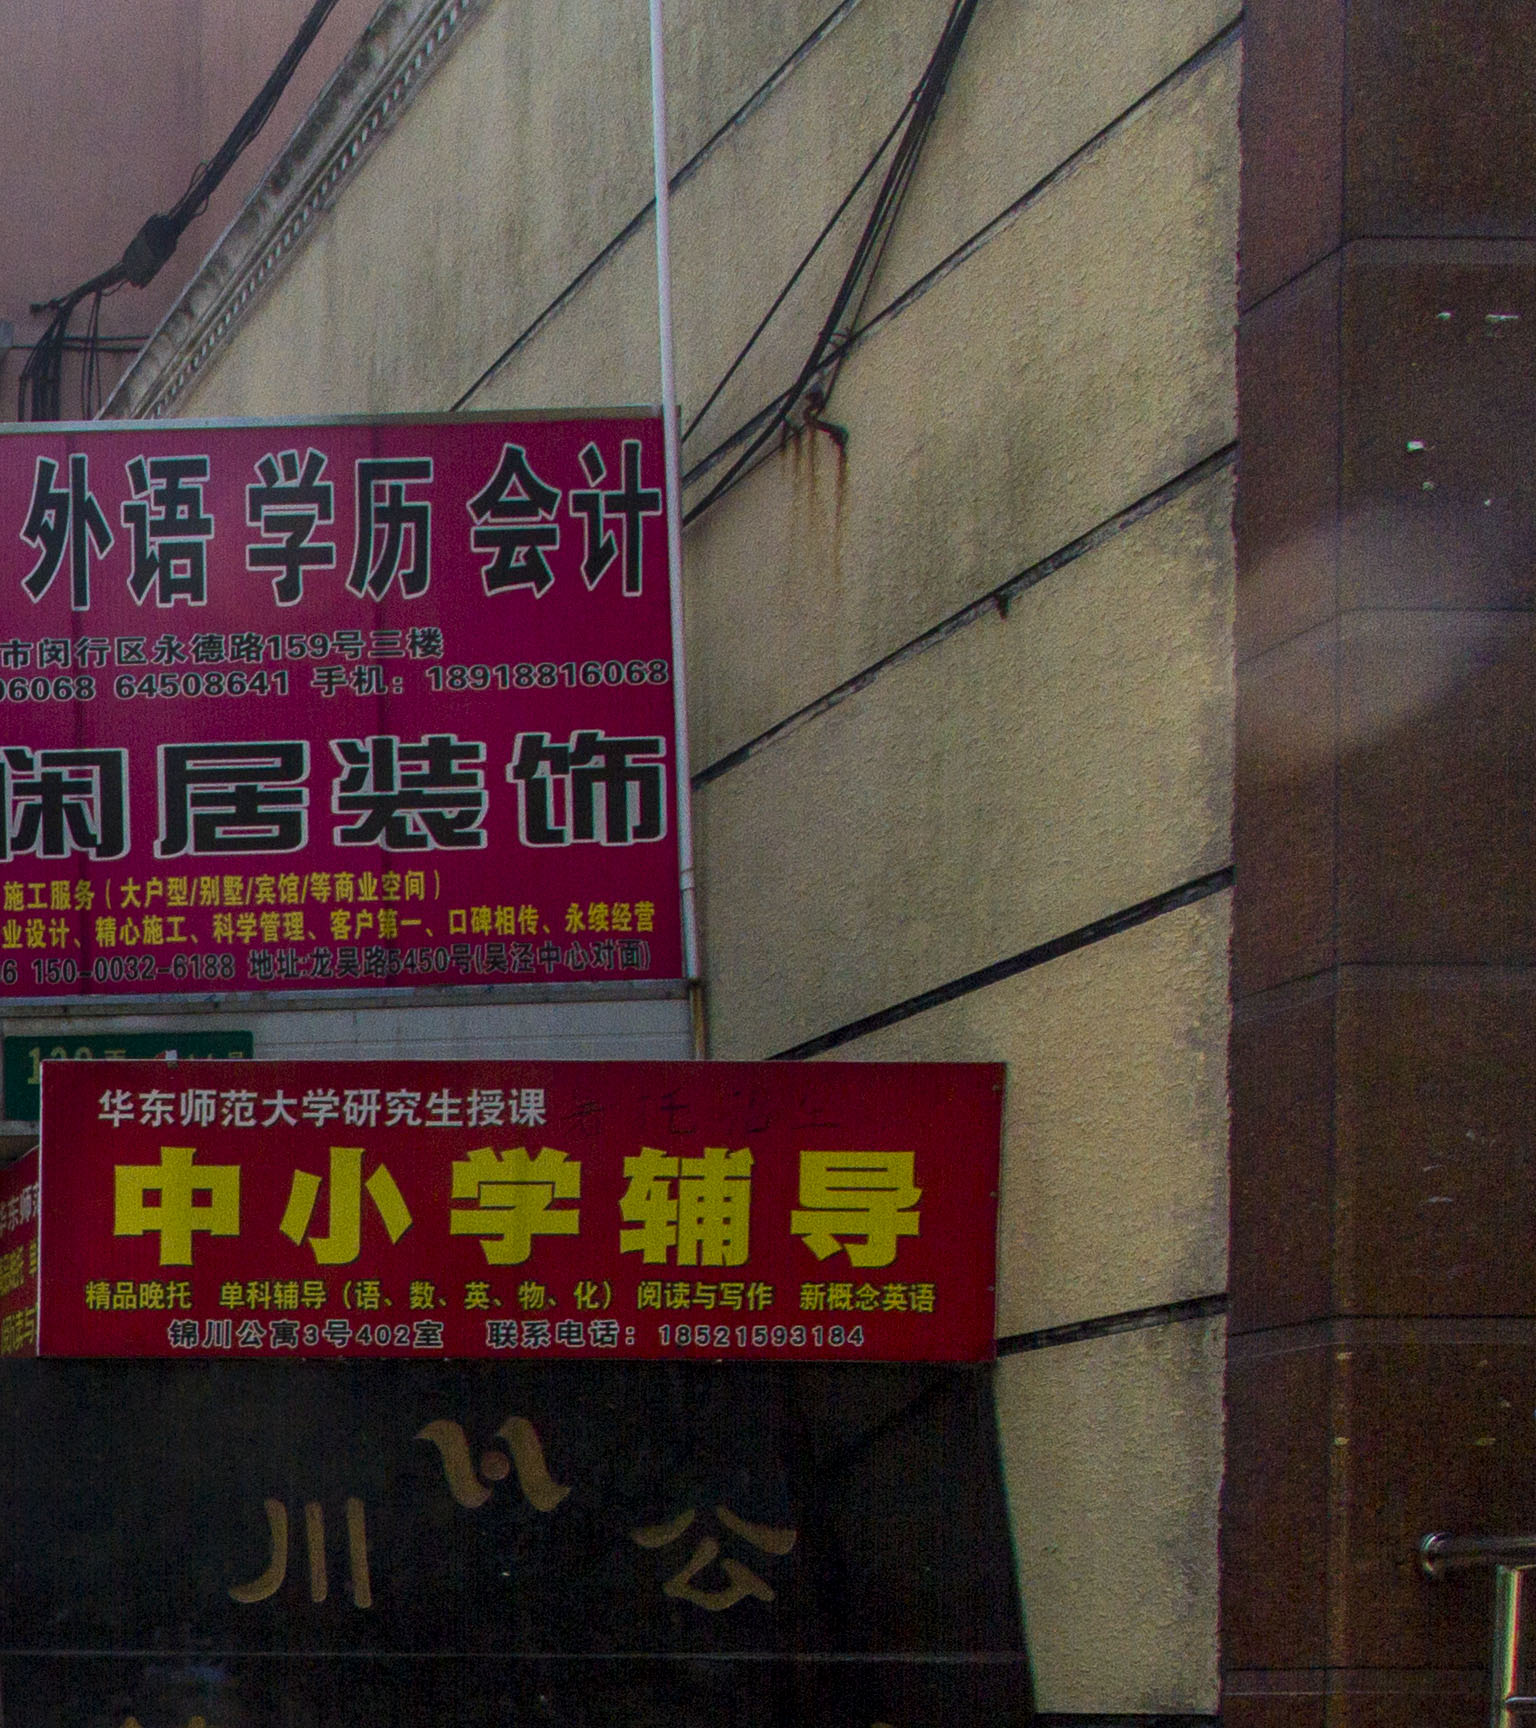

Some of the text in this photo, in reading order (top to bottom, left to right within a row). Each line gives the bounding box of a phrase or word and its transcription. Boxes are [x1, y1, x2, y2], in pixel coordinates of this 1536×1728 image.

[21, 453, 214, 611] 外语
[245, 448, 432, 606] 学历
[468, 440, 664, 601] 会计
[114, 671, 289, 699] 64508641
[32, 953, 236, 983] 150-0032-6188
[98, 1088, 548, 1128] 华东师范大学研究生授课
[112, 1146, 923, 1267] 中小学辅导
[85, 1280, 193, 1311] 精品晚托
[636, 1281, 774, 1312] 阅读与写作
[798, 1281, 936, 1314] 新概念英语
[167, 1319, 445, 1348] 锦川公寓3号402室
